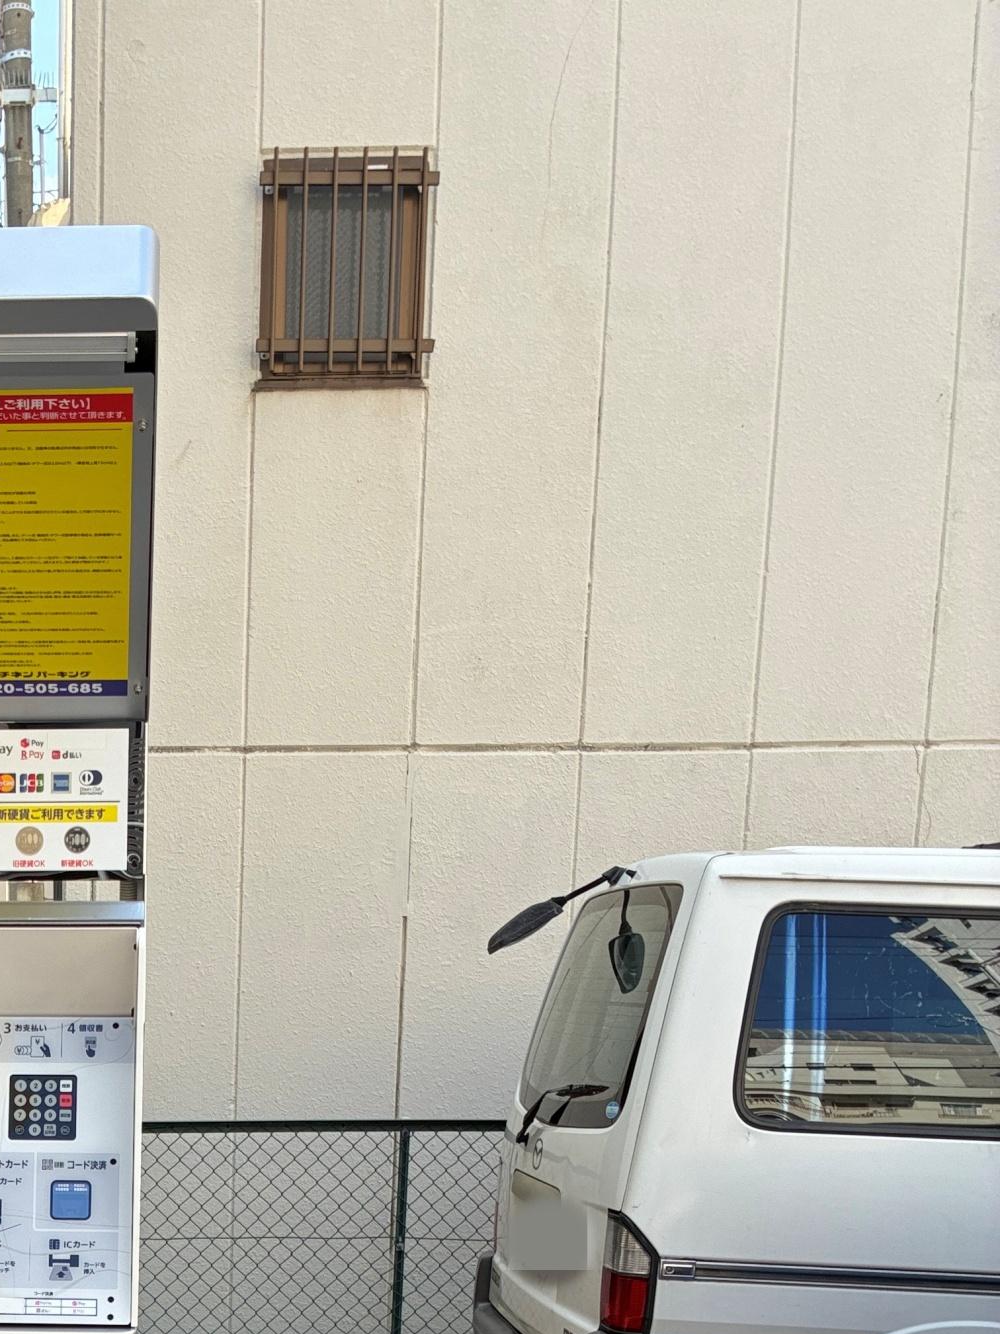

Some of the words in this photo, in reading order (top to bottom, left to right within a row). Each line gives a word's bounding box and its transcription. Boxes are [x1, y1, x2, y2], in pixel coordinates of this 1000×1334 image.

[31, 740, 44, 748] Pay
[20, 773, 44, 793] JCB
[12, 860, 45, 868] 旧硬貨OK
[61, 859, 94, 867] 新硬貨OK
[3, 1022, 12, 1034] 3
[67, 1022, 76, 1034] 4
[79, 1024, 104, 1032] 領収書
[67, 1160, 108, 1170] コード決済
